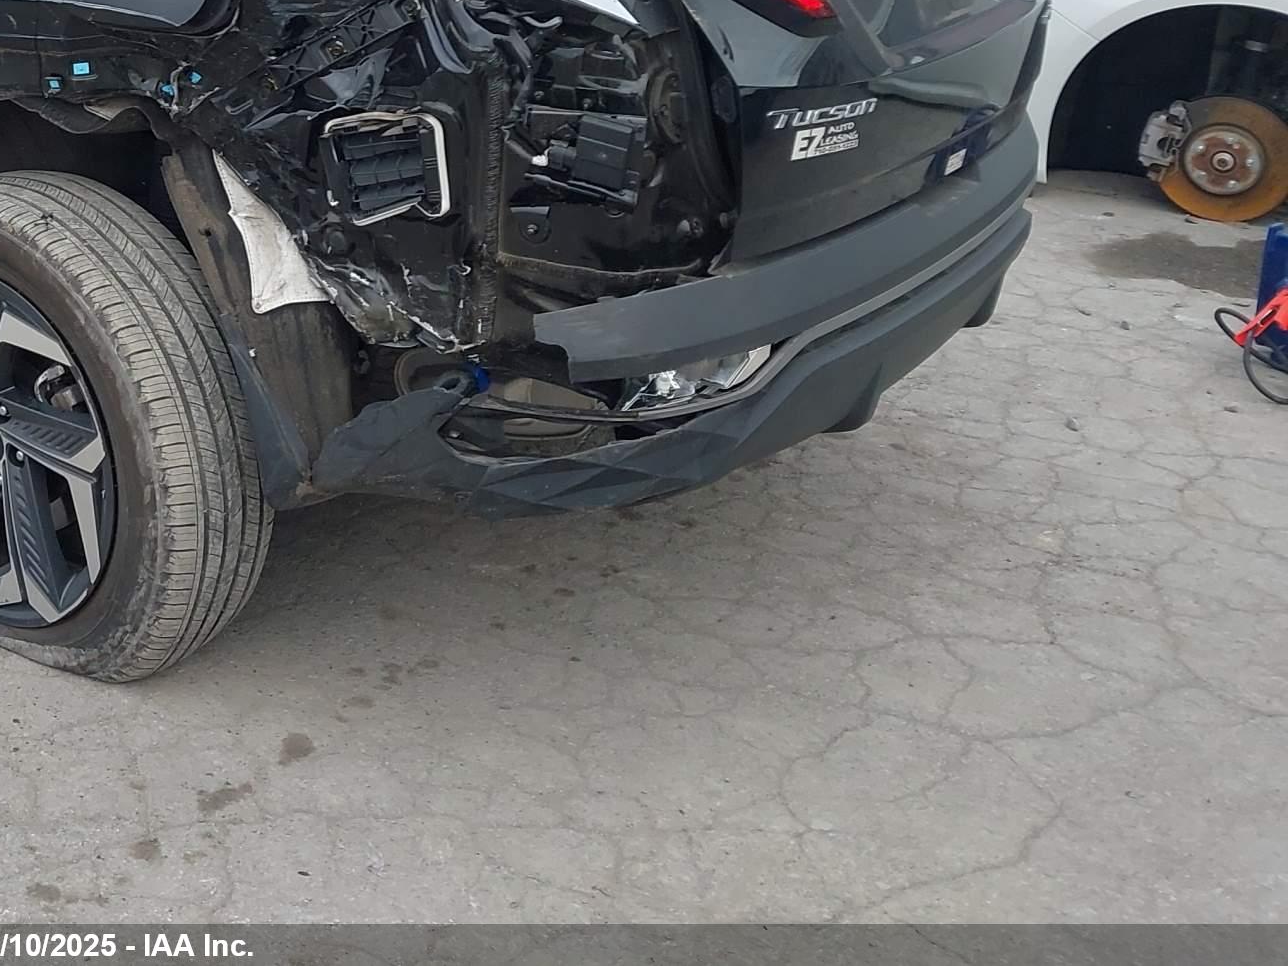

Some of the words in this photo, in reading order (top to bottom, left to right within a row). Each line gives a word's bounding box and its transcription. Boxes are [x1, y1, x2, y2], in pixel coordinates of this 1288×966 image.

[828, 121, 856, 135] AUTO
[790, 126, 826, 161] EZ
[820, 130, 859, 146] LEASING
